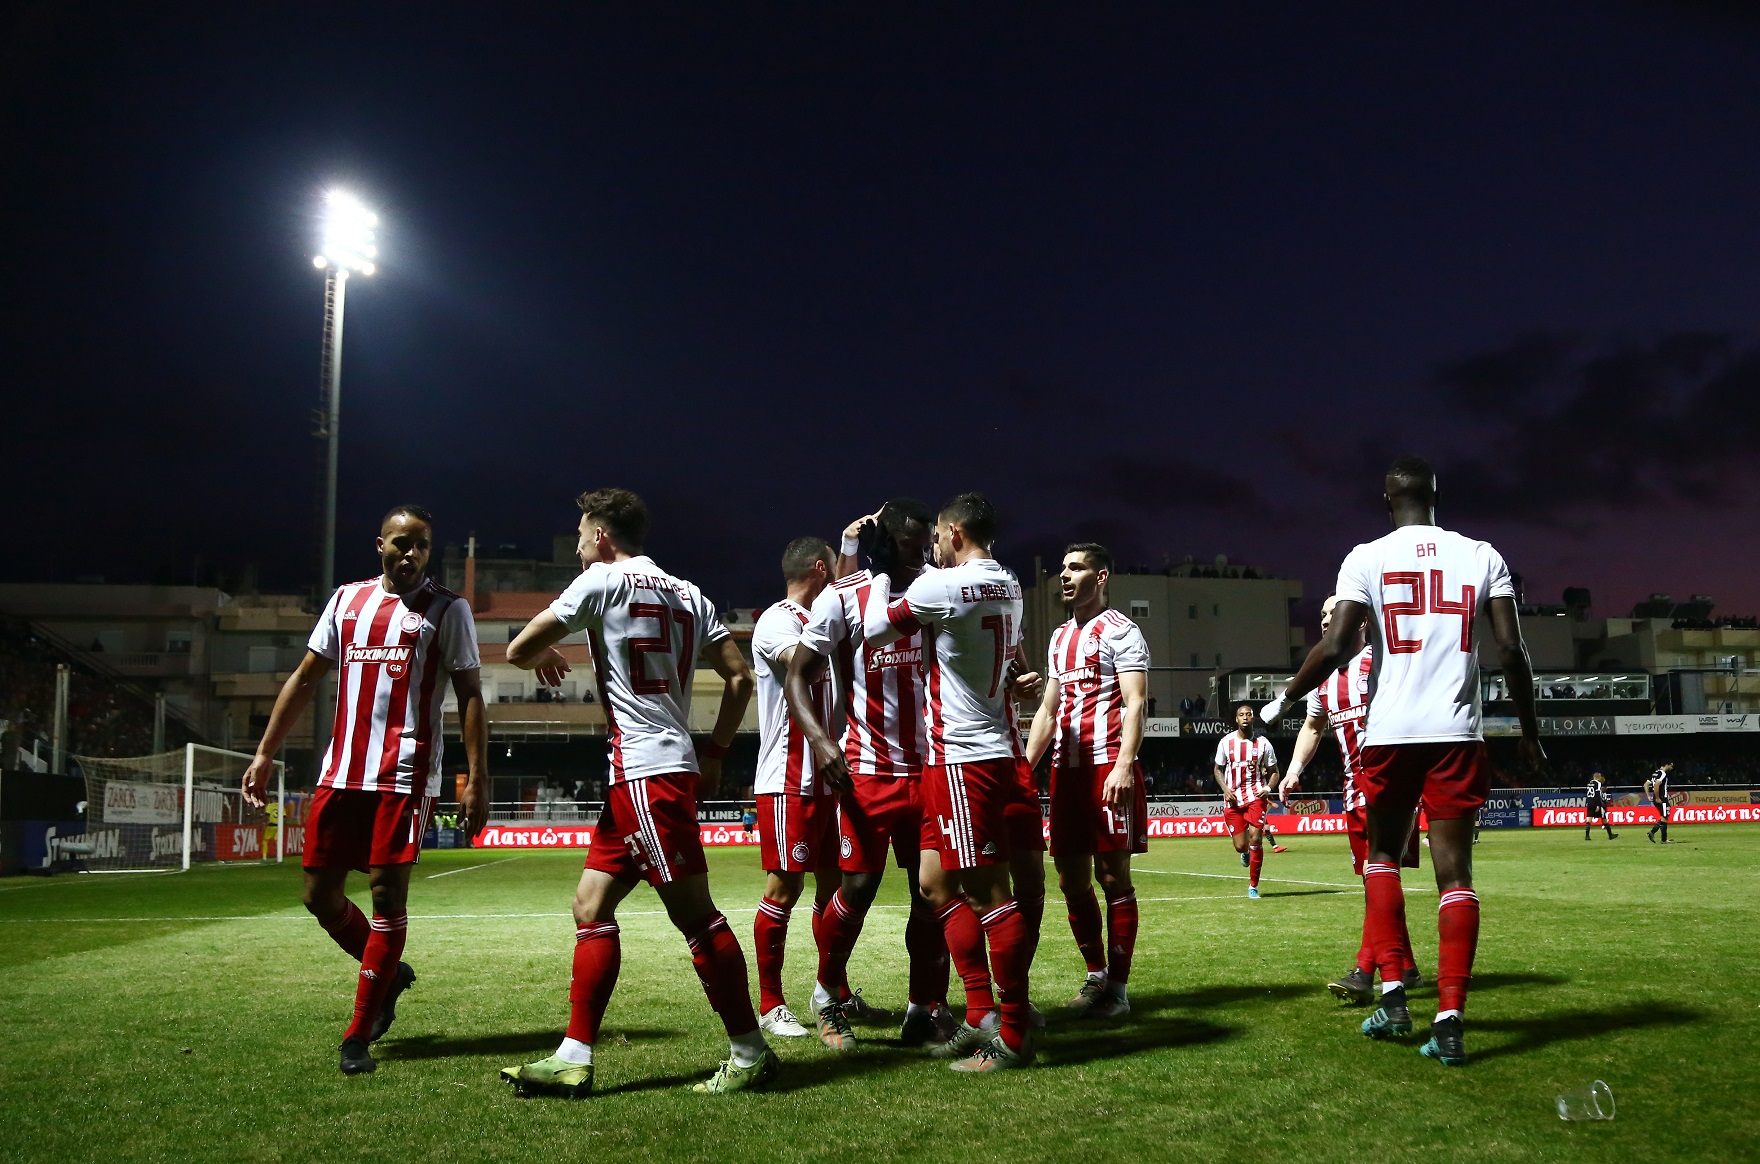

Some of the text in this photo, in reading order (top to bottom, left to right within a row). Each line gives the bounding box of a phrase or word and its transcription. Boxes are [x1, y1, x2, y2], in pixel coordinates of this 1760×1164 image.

[1416, 543, 1437, 558] BA
[1383, 569, 1476, 654] 24
[345, 646, 411, 671] STOIXIMAN
[390, 663, 402, 673] GR
[871, 648, 922, 669] STOIXIMA
[710, 811, 741, 820] LINES
[232, 828, 259, 857] SYM
